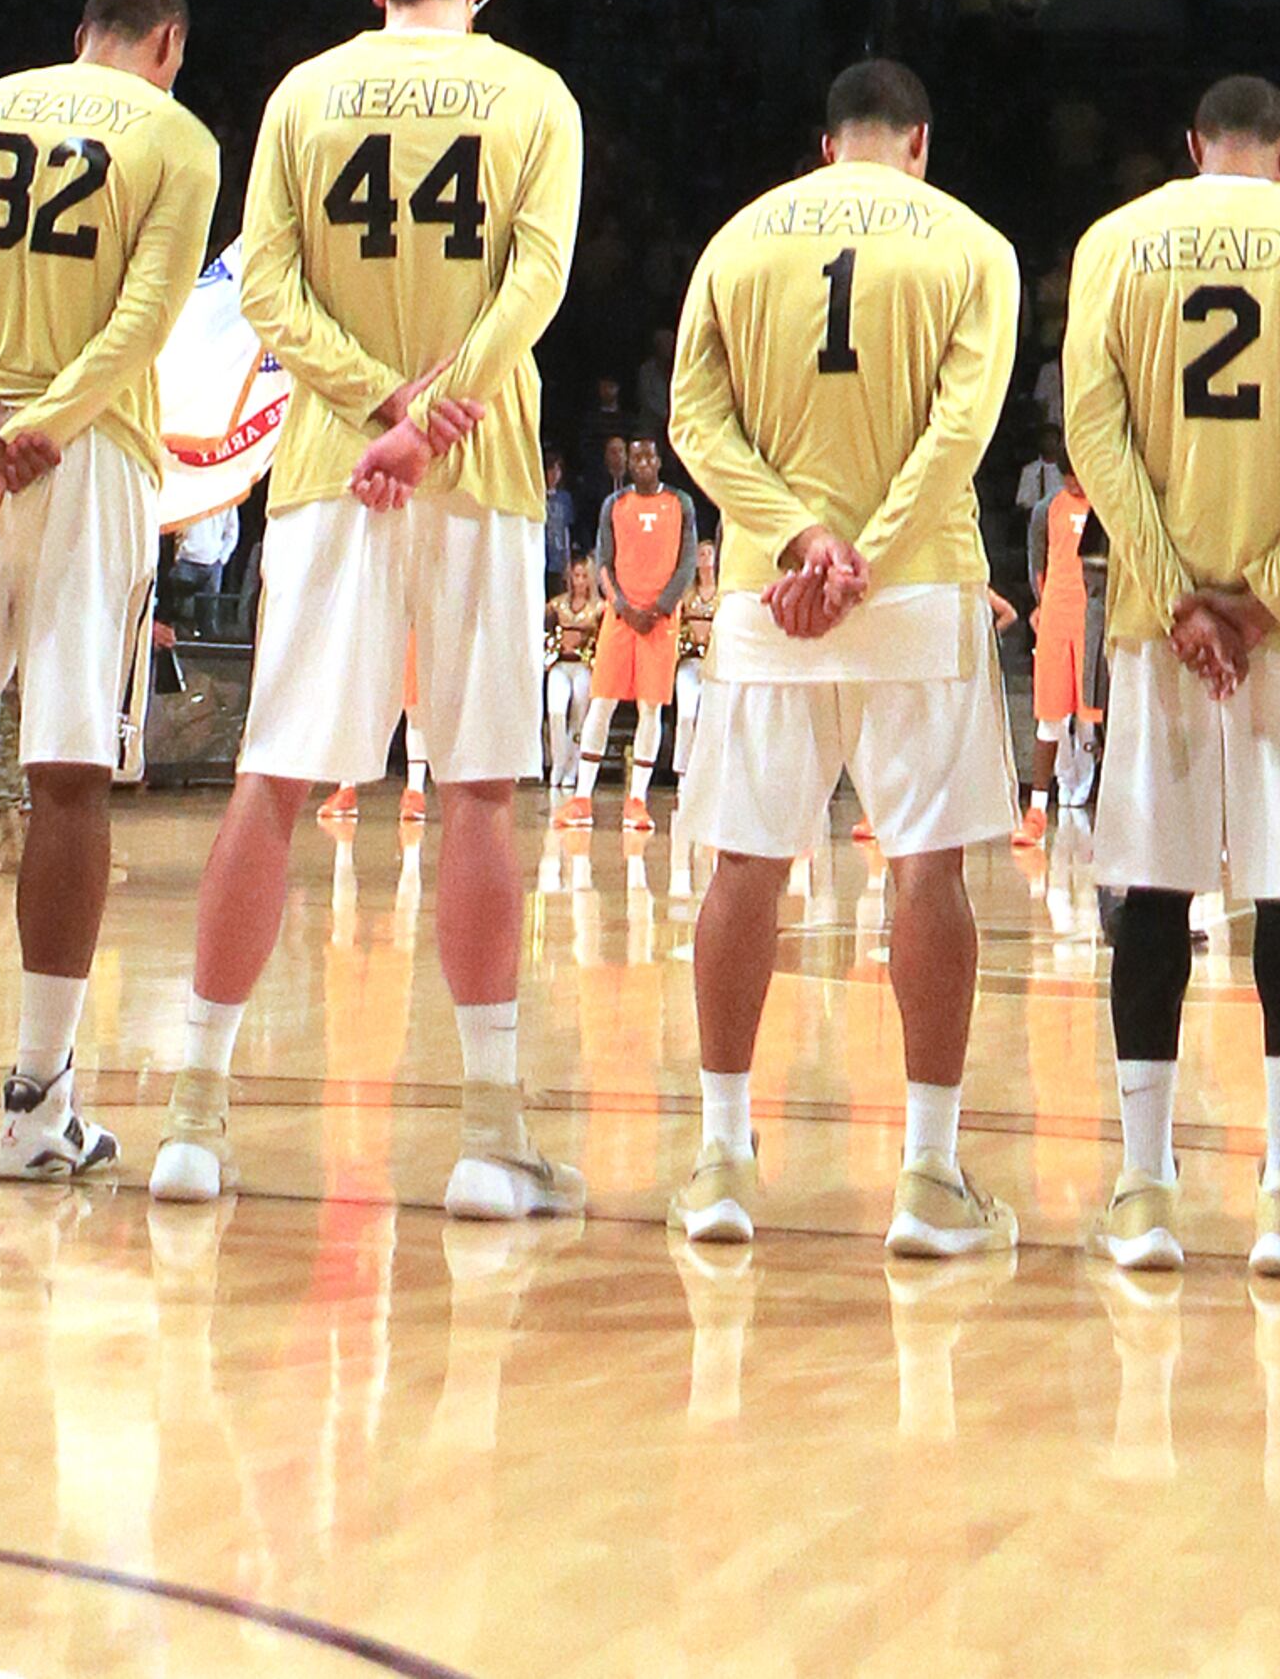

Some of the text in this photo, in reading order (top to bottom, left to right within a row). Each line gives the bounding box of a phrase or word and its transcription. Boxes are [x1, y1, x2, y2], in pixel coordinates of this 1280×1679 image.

[325, 79, 506, 120] READY
[323, 134, 487, 260] 44
[752, 196, 958, 242] READY
[818, 248, 859, 374] 1
[1182, 285, 1263, 420] 2
[638, 512, 658, 533] T
[1069, 513, 1088, 535] T
